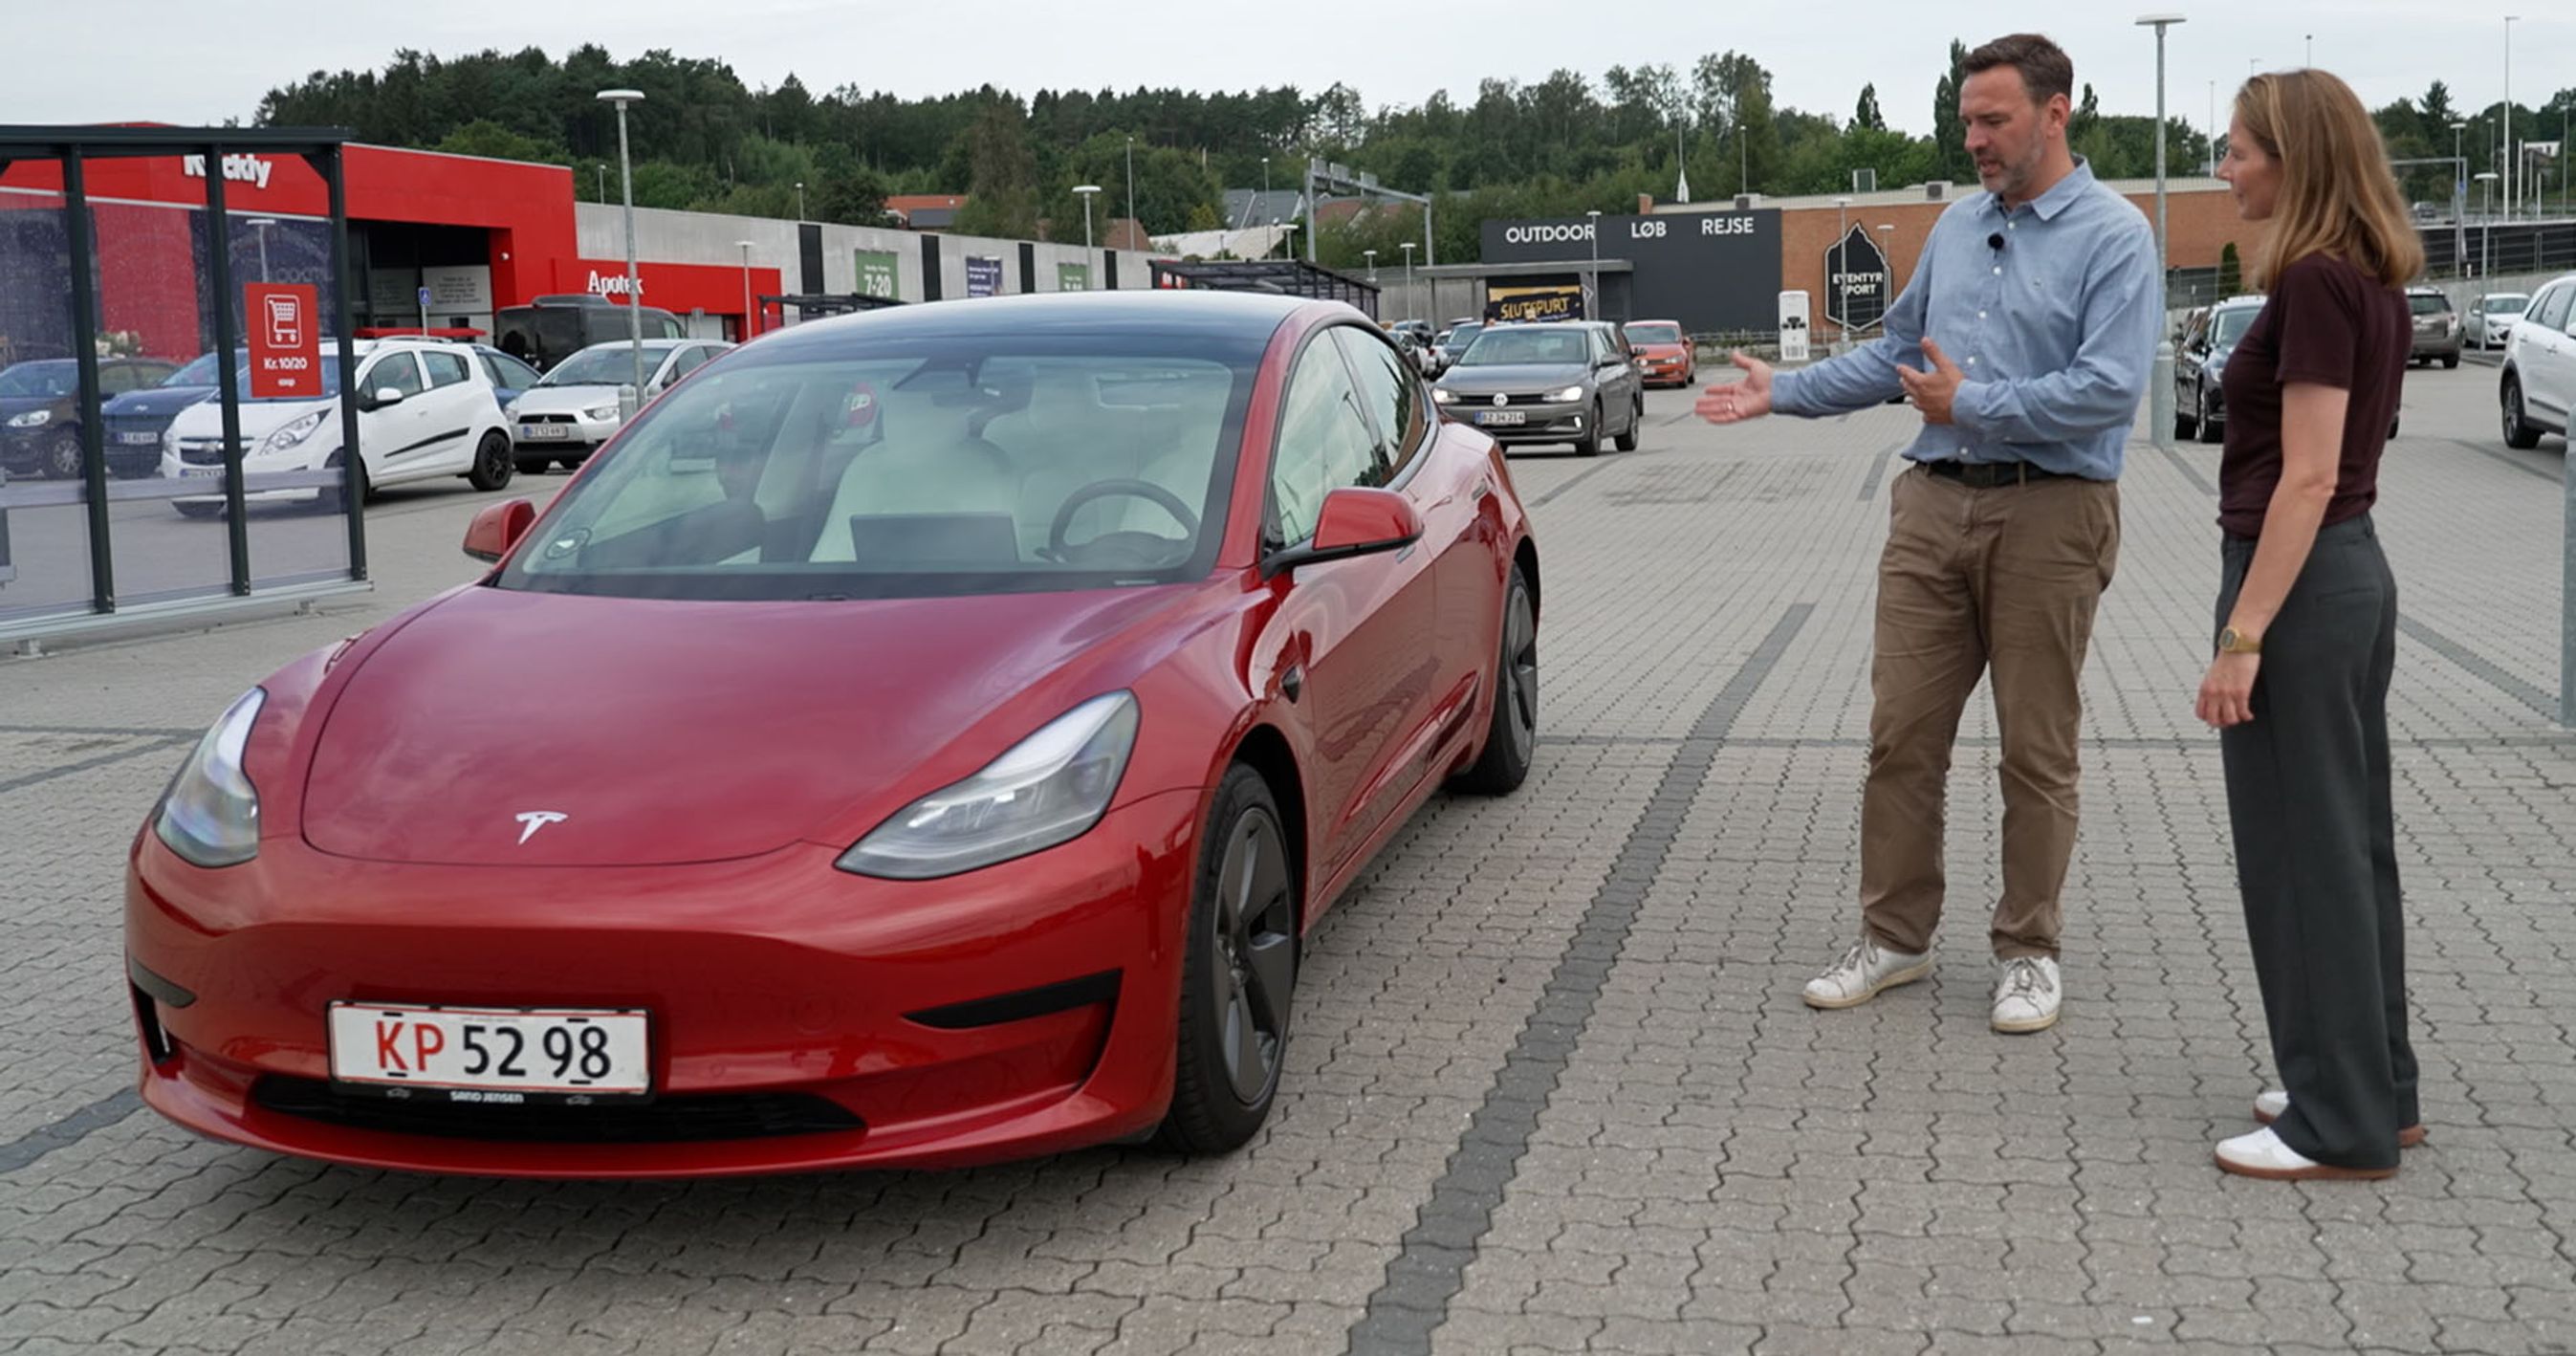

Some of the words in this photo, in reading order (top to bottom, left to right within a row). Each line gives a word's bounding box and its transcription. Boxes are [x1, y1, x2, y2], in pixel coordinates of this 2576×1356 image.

[183, 153, 273, 188] Kckly
[1506, 224, 1595, 244] OUTDOOR
[1630, 221, 1668, 238] LØB
[1701, 216, 1755, 236] REJSE
[376, 1020, 446, 1072] KP
[464, 1025, 527, 1077] 52
[542, 1026, 612, 1080] 98
